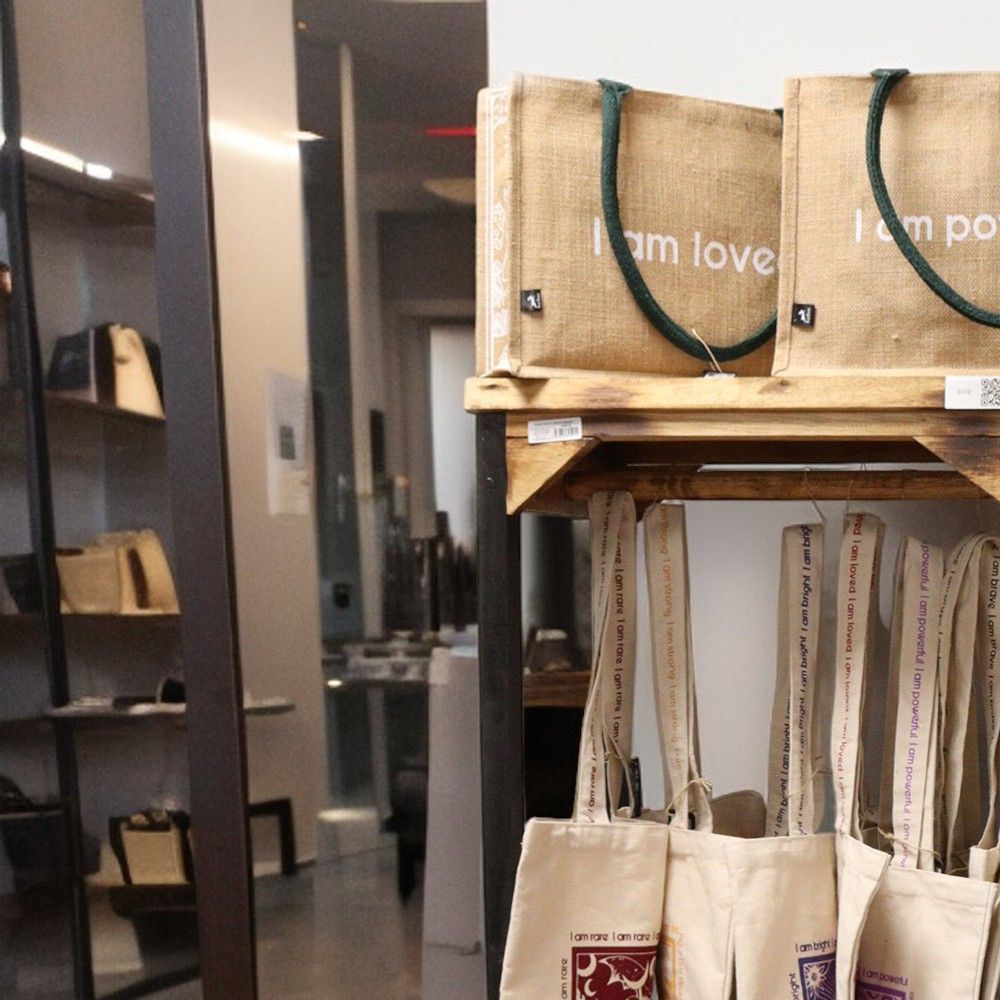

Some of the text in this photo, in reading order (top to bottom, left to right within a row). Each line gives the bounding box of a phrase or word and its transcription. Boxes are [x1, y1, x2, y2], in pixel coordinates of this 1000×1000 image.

[855, 208, 862, 243] I
[594, 216, 601, 256] I
[693, 231, 780, 276] love
[804, 548, 812, 565] am
[851, 545, 859, 561] am
[919, 544, 931, 592] powerful
[991, 561, 1000, 577] am
[615, 574, 624, 591] am
[848, 563, 858, 594] loved
[801, 575, 812, 606] bright
[987, 579, 1000, 609] brave
[616, 593, 625, 615] rare
[847, 604, 855, 620] am
[918, 600, 928, 616] am
[801, 608, 809, 627] am
[616, 624, 625, 641] am
[846, 622, 854, 653] loved
[987, 620, 996, 638] am
[915, 617, 927, 665] powerful
[615, 643, 625, 664] rare
[800, 636, 810, 668] bright
[614, 673, 622, 690] am
[800, 669, 808, 688] am
[912, 673, 922, 691] am
[614, 691, 623, 713] rare
[910, 691, 920, 738] powerful
[838, 740, 847, 772] loved
[907, 748, 916, 766] am
[776, 806, 786, 823] am
[783, 753, 790, 771] am
[903, 766, 914, 815] powerful
[574, 933, 589, 941] am
[590, 932, 609, 941] rare
[617, 933, 632, 941] am
[800, 943, 813, 952] am
[560, 958, 568, 980] rare
[867, 970, 879, 978] am
[560, 982, 567, 1000] am
